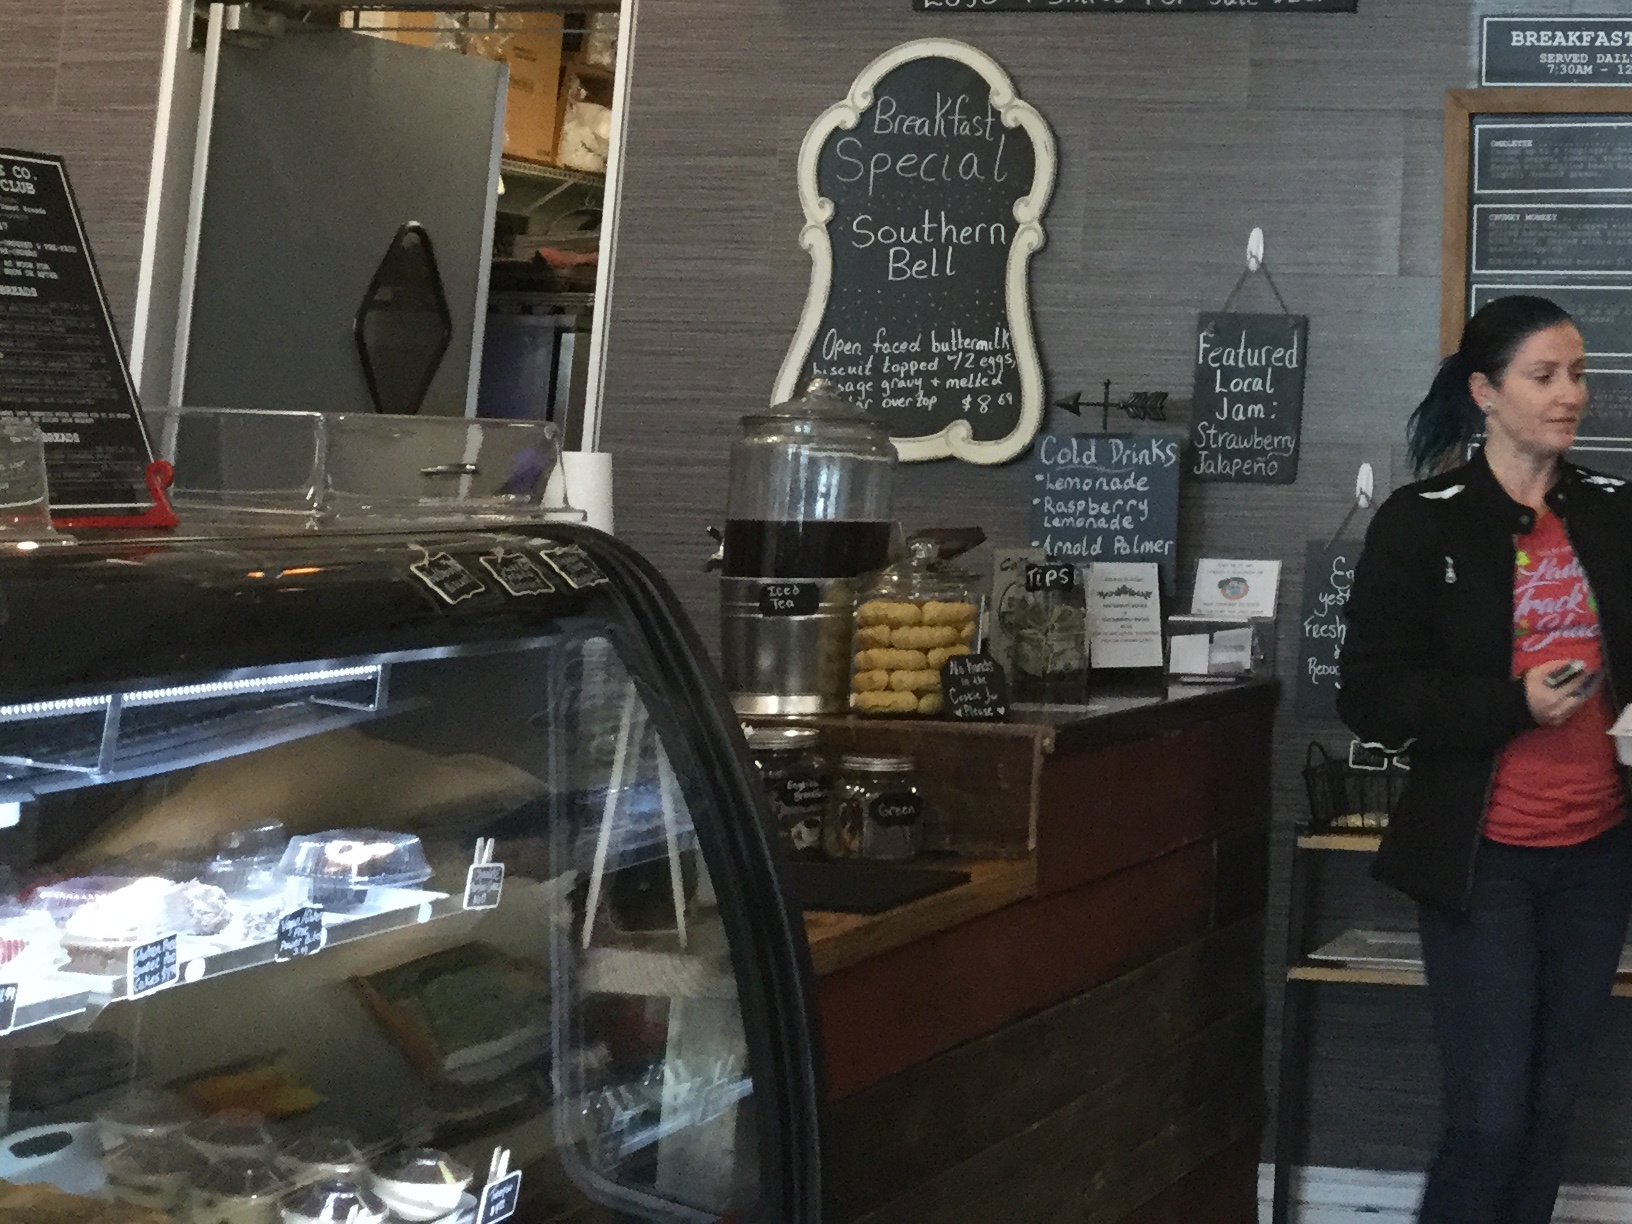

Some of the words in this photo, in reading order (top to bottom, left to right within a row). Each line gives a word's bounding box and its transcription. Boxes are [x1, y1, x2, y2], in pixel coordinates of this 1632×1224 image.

[1539, 53, 1589, 64] SERVED
[1547, 64, 1593, 75] 7:30AM
[874, 91, 995, 141] Breakfast
[836, 134, 1008, 196] Special
[852, 209, 1007, 249] Southern
[887, 246, 956, 281] Bell
[822, 327, 862, 361] Open
[873, 327, 922, 354] faced
[931, 326, 1011, 353] buttermilk
[1198, 329, 1299, 368] Featured
[883, 356, 939, 377] topped
[980, 352, 1017, 375] eggs,
[882, 378, 923, 397] gravy
[946, 373, 1004, 390] melted
[1215, 367, 1275, 394] Local
[1040, 435, 1097, 465] Cold
[1108, 438, 1178, 467] Drinks
[1194, 421, 1296, 458] Strawberry
[1194, 451, 1278, 478] Jalapeño
[1046, 472, 1149, 491] Lemonade
[1043, 496, 1149, 521] Raspberry
[1043, 513, 1134, 530] Lemonade
[1043, 534, 1103, 556] Arnold
[1113, 534, 1175, 555] Palmer
[767, 584, 800, 597] Iced
[770, 598, 795, 610] Tea
